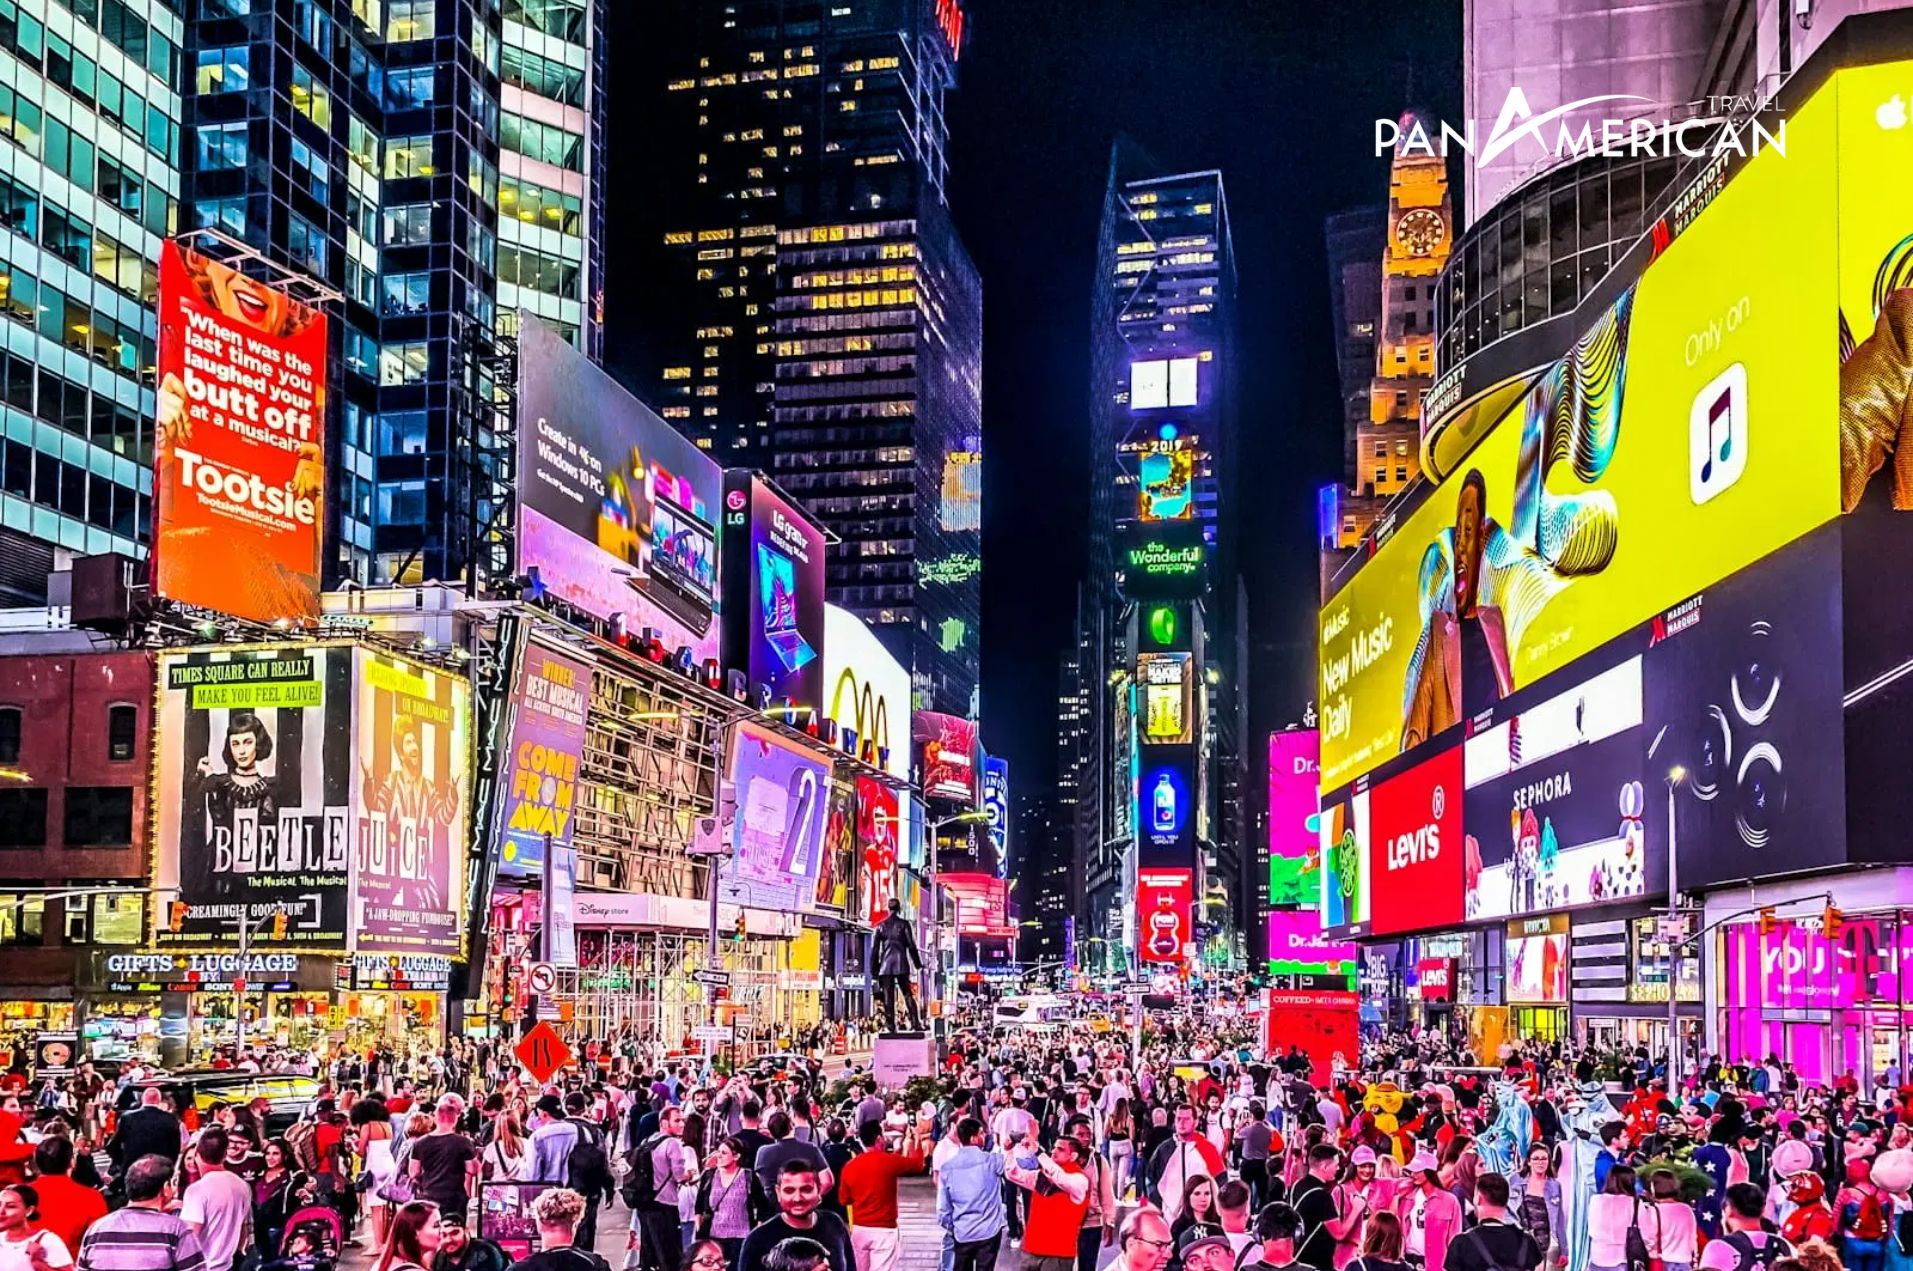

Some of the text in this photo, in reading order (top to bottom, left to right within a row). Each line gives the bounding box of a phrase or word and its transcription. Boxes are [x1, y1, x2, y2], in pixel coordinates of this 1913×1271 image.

[1674, 149, 1730, 219] MARRIOTT
[1675, 178, 1724, 237] MARQUIS
[1685, 295, 1750, 367] Only on
[185, 325, 313, 394] last time you
[246, 338, 281, 363] was
[284, 351, 312, 376] the
[184, 346, 312, 412] laughed your
[1426, 364, 1467, 411] MARRIOTT
[183, 366, 312, 440] butt off
[190, 404, 209, 422] at
[213, 412, 225, 427] a
[537, 417, 568, 450] Create
[567, 436, 577, 456] in
[590, 457, 602, 473] on
[1150, 440, 1183, 452] 2019
[537, 439, 579, 479] Windows
[579, 468, 589, 486] 10
[589, 474, 606, 496] PCs
[174, 447, 315, 525] Tootsie
[196, 491, 297, 532] TootsieMusical.com
[727, 513, 745, 525] LG
[773, 509, 784, 532] LG
[1130, 547, 1199, 564] Wonderful
[1147, 542, 1164, 552] the
[1327, 605, 1350, 640] Music
[1667, 595, 1703, 622] MARRIOTT
[1667, 607, 1699, 637] MARQUIS
[171, 660, 310, 684] TIMES SQUARE CAN REALLY
[1323, 611, 1393, 700] New Music
[542, 659, 576, 689] WINNER!
[198, 684, 319, 704] MAKE YOU FEEL ALIVE!
[526, 674, 584, 715] BEST MUSICAL
[1324, 693, 1353, 745] Daily
[518, 741, 578, 782] COME
[512, 769, 575, 811] FROM
[1513, 771, 1572, 810] SEPHORA
[508, 801, 571, 838] AWAY
[213, 815, 346, 873] BEETLE
[968, 824, 976, 856] 1500
[247, 877, 261, 886] The
[299, 876, 314, 886] The
[375, 908, 420, 923] JAW-DROPPING
[576, 902, 629, 918] Disney store
[108, 954, 297, 972] GIFTS LUGGAGE
[352, 956, 452, 972] GIFTS LUGGAGE
[1765, 946, 1825, 975] YOU
[204, 983, 235, 991] SONY
